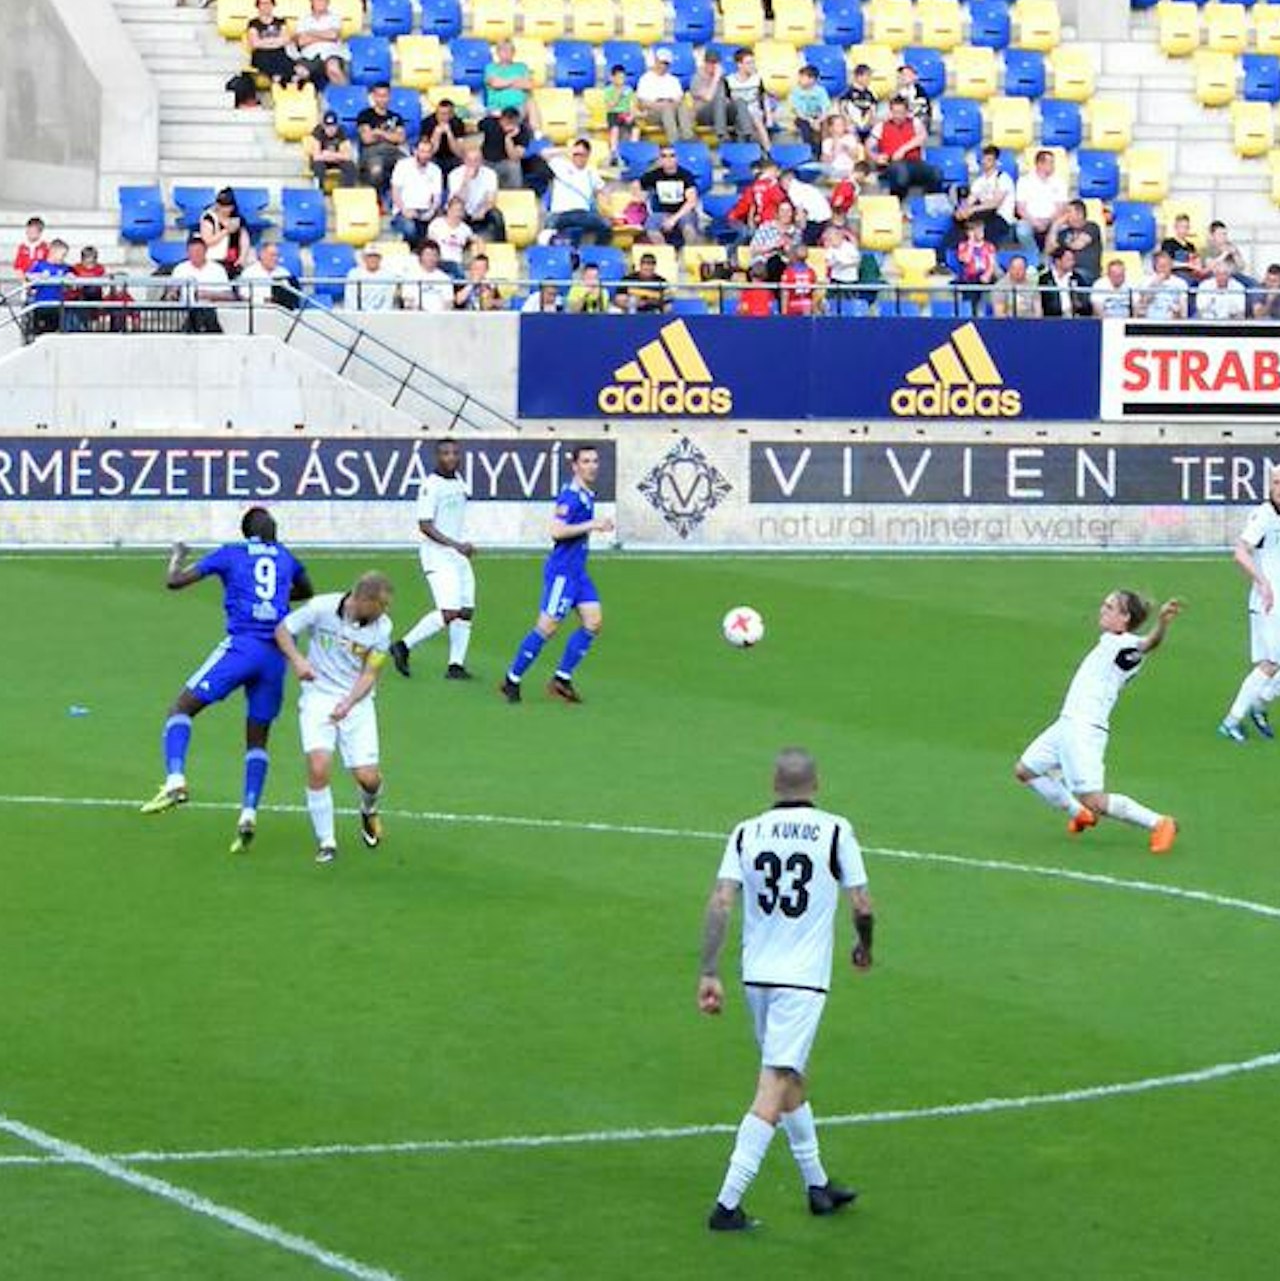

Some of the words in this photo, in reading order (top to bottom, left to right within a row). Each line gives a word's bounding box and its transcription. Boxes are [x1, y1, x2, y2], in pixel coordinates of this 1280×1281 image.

[598, 380, 732, 415] adidas
[890, 382, 1021, 417] adidas
[764, 446, 1117, 498] VIVIEN
[757, 510, 875, 539] natural
[886, 512, 1011, 539] mineral
[1021, 515, 1120, 540] water
[254, 556, 277, 601] 9
[753, 851, 813, 919] 33
